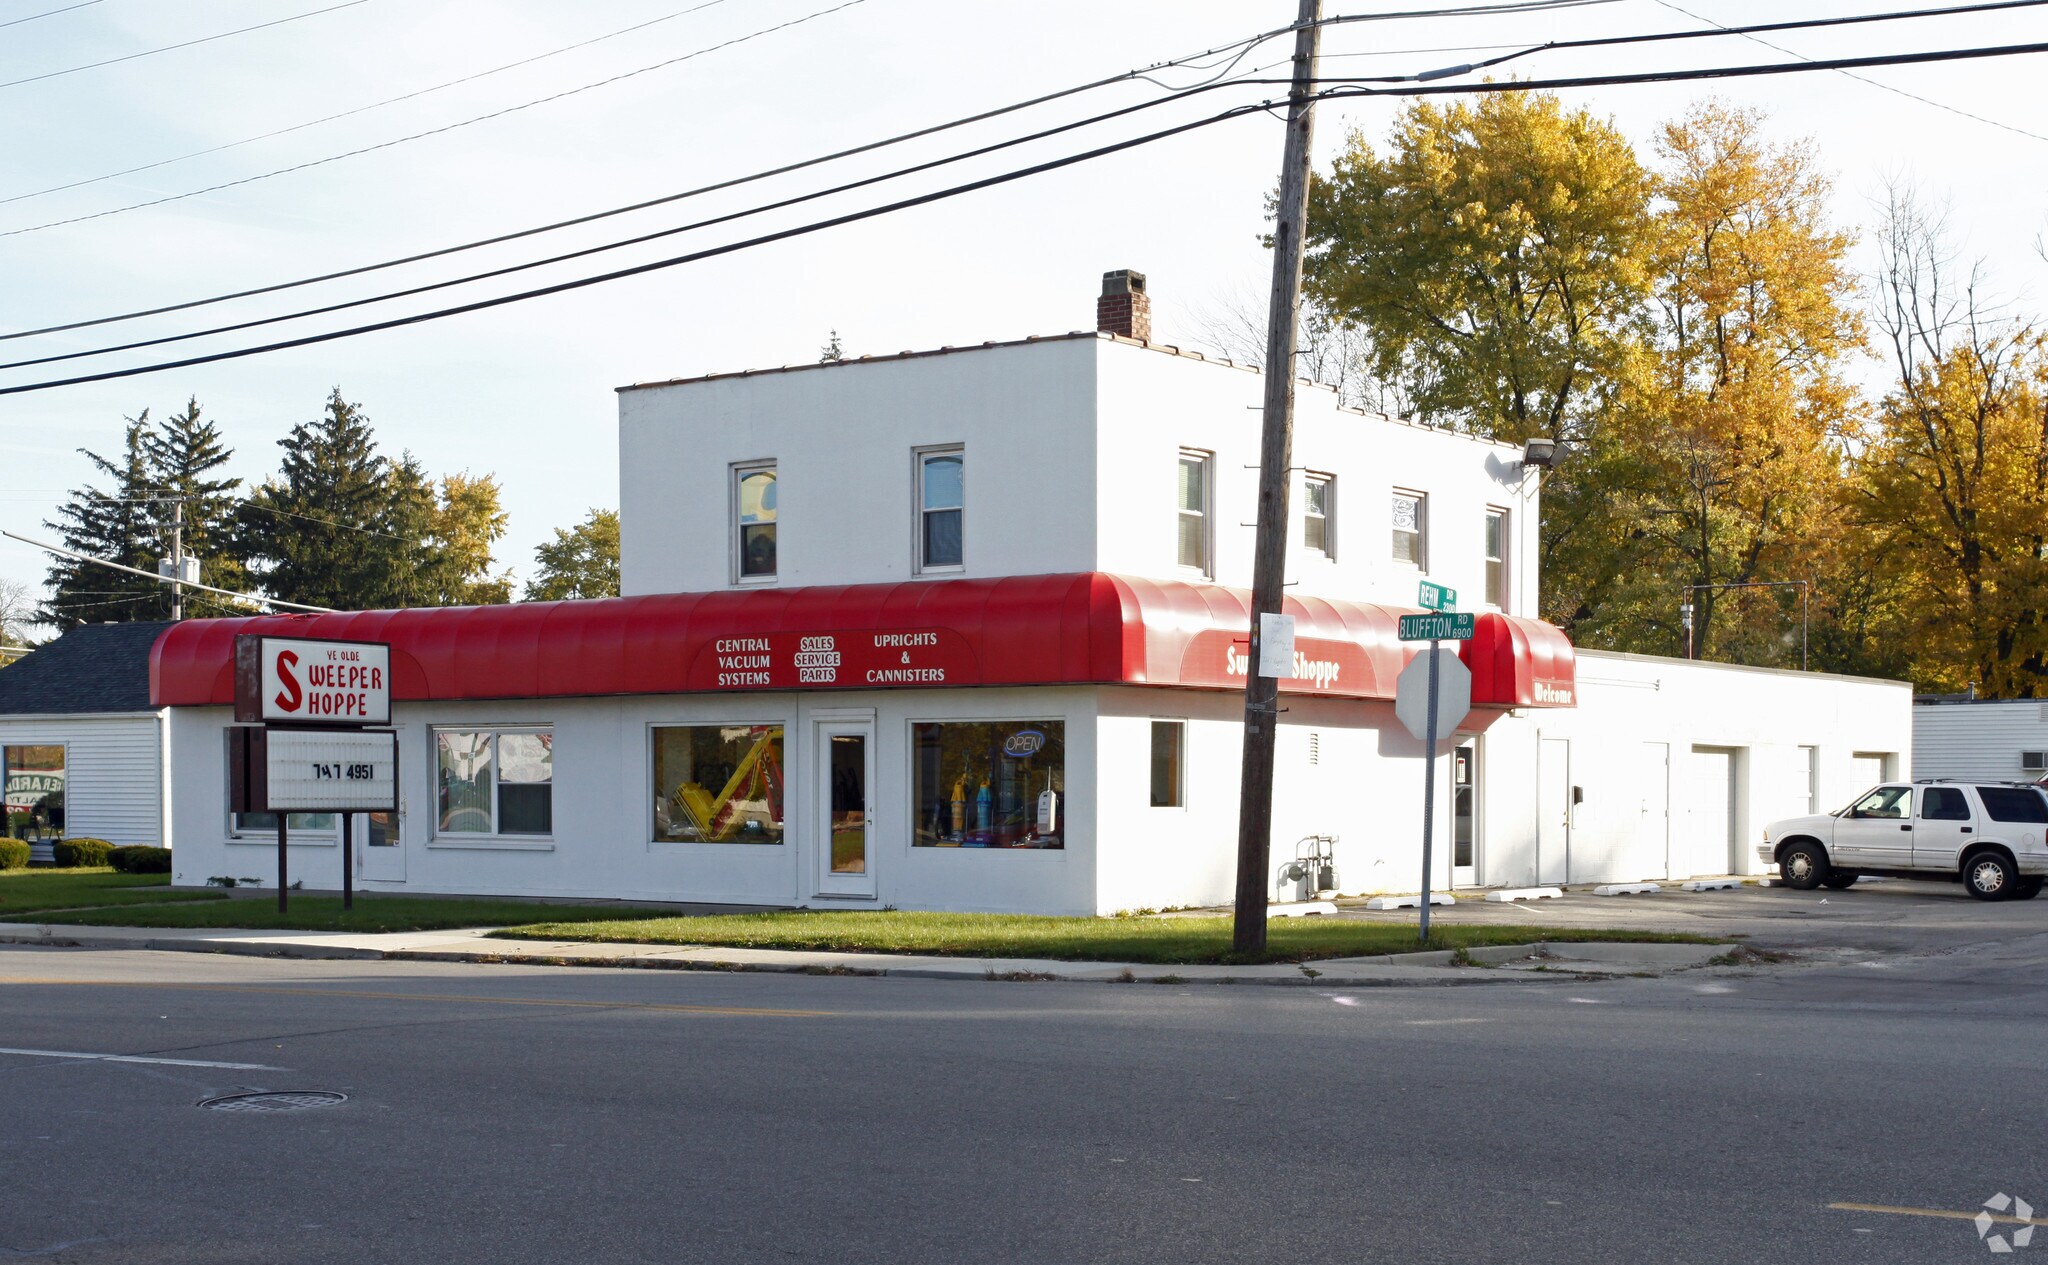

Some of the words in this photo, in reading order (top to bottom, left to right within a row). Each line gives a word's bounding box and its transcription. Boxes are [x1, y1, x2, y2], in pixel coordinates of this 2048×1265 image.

[1420, 584, 1439, 608] REHM
[1446, 589, 1454, 601] DR
[1443, 602, 1456, 614] 2300
[1400, 618, 1452, 638] BLUFFTON
[1457, 615, 1468, 625] RD
[1453, 628, 1472, 638] 6900
[716, 638, 771, 652] CENTRAL
[801, 637, 834, 651] SALES
[874, 632, 937, 647] UPRIGHTS
[327, 651, 337, 661] YE
[340, 651, 360, 661] OLDE
[719, 655, 770, 668] VACUUM
[795, 652, 840, 667] SERVICE
[901, 651, 910, 664] &
[800, 668, 836, 682] PARTS
[866, 668, 945, 682] CANNISTERS
[1291, 651, 1340, 689] Shoppe
[308, 665, 382, 690] WEEPER
[718, 672, 770, 685] SYSTEMS
[1534, 682, 1572, 704] Welcome
[308, 692, 367, 716] HOPPE
[1006, 736, 1041, 751] OPEN
[346, 764, 373, 780] 4951
